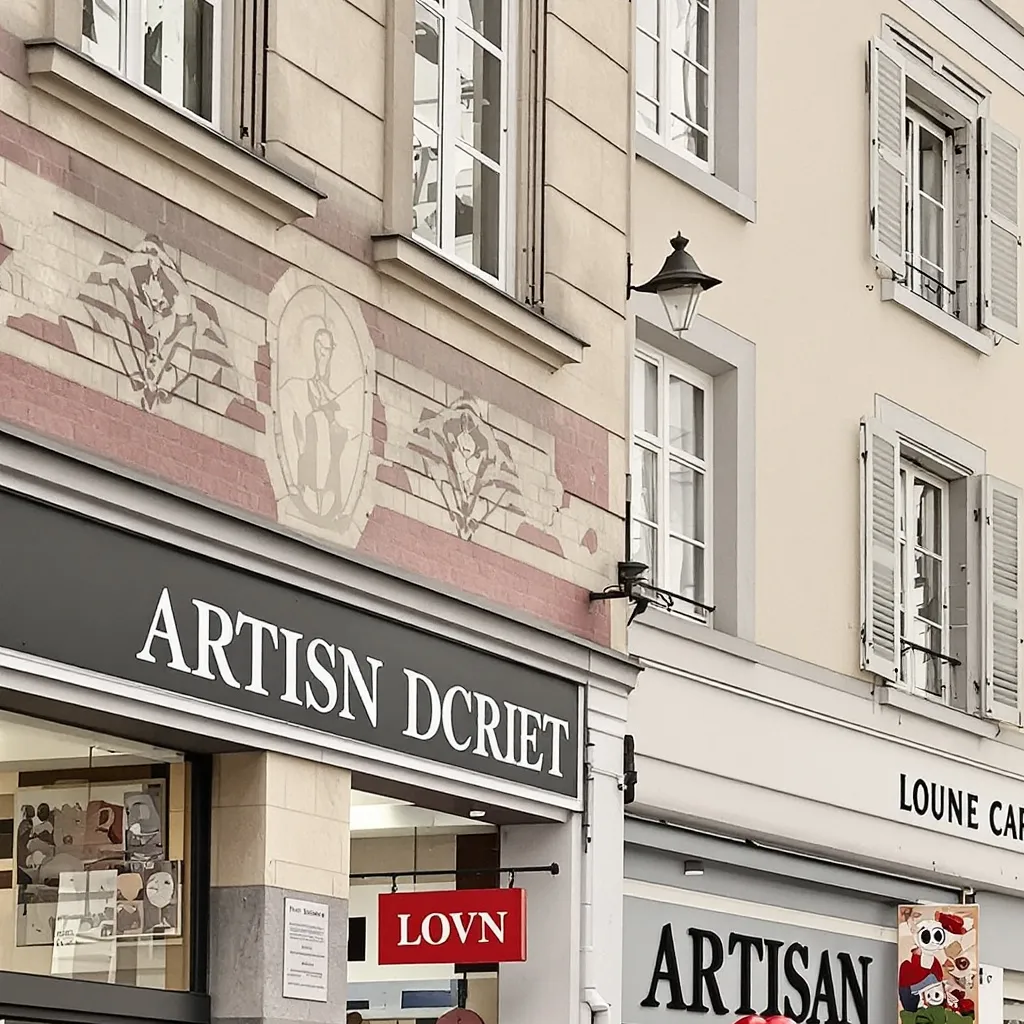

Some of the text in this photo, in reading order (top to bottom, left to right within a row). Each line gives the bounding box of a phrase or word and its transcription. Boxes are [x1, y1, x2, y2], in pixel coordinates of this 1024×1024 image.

[136, 587, 570, 778] ARTISN DCRIET
[900, 773, 979, 830] LOUNE
[397, 911, 507, 946] LOVN
